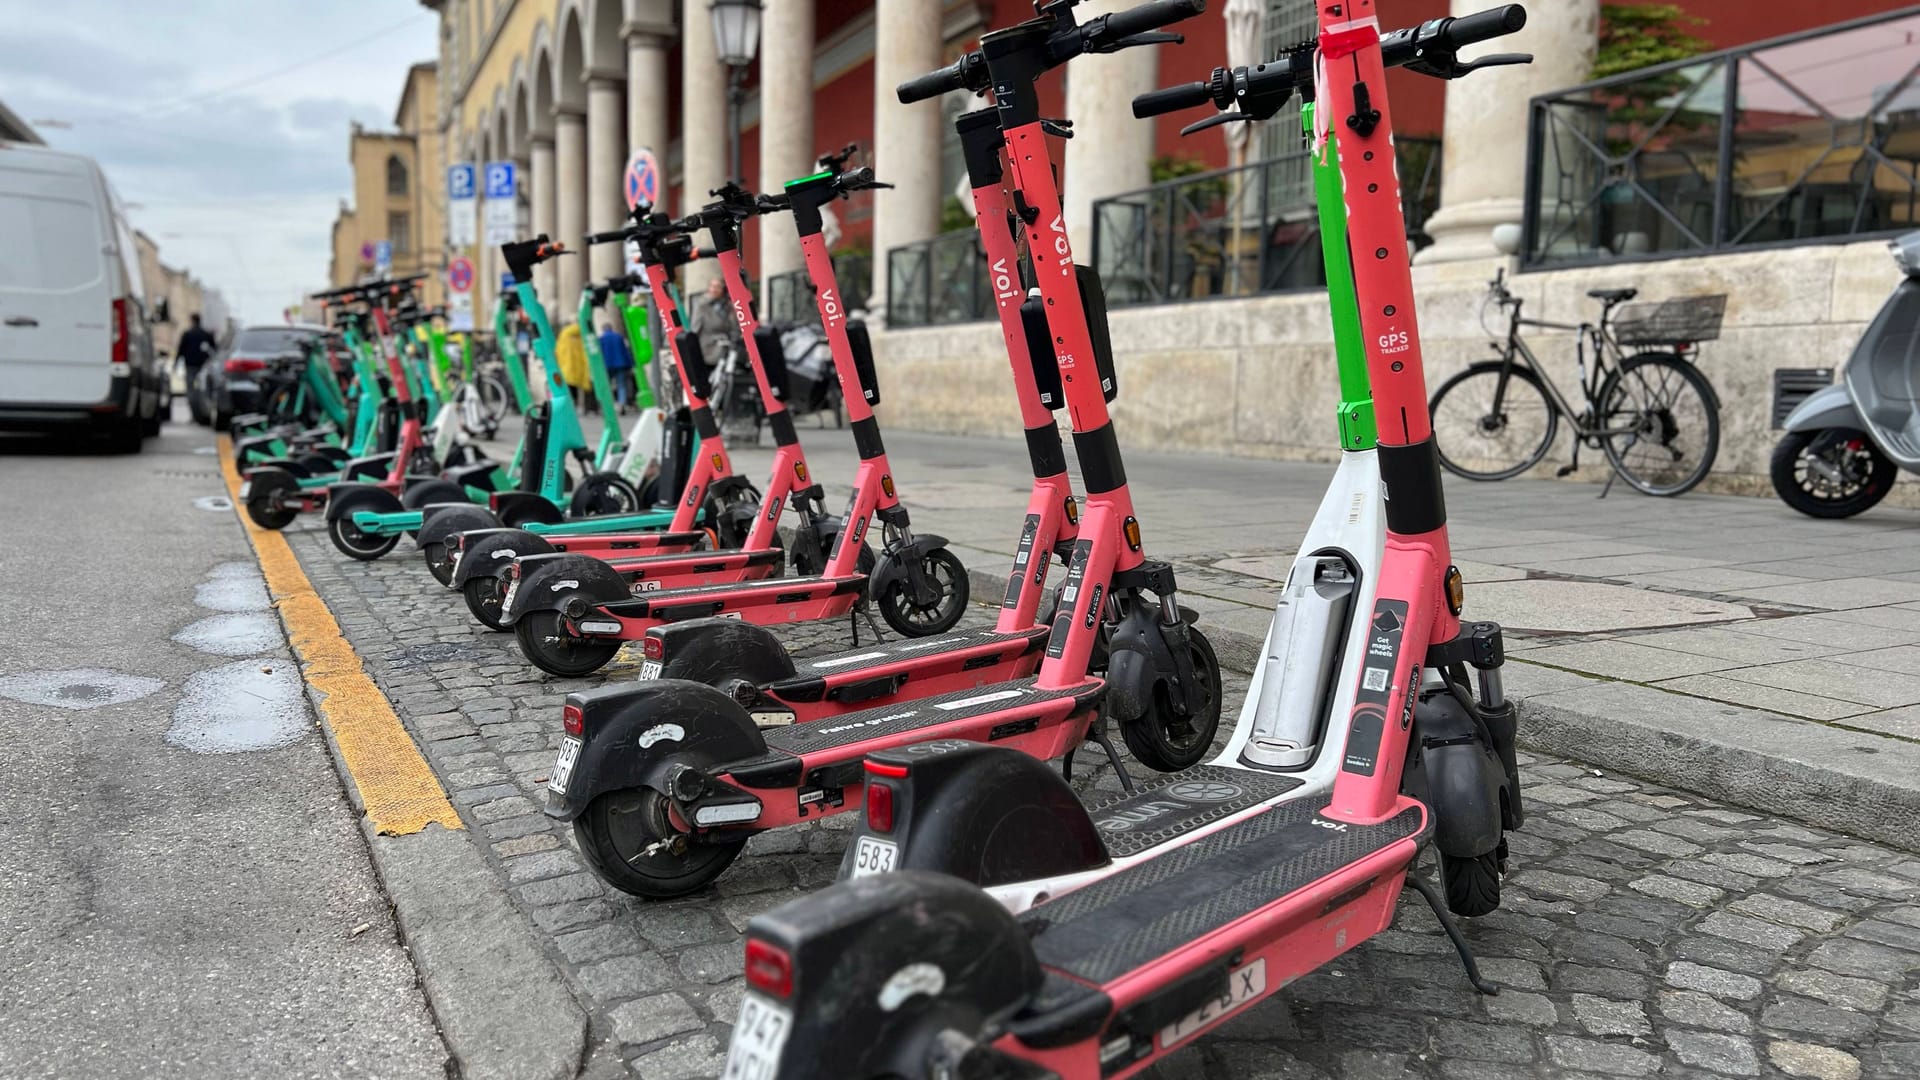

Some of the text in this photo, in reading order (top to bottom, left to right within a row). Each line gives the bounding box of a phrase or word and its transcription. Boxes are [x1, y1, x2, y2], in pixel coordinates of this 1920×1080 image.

[993, 258, 1018, 307] voi.
[733, 300, 751, 333] voi.
[822, 289, 842, 328] voi.
[1379, 331, 1408, 348] GPS
[1381, 344, 1409, 355] TRACKED
[1372, 643, 1393, 651] magic
[1377, 636, 1389, 644] Get
[1369, 649, 1393, 657] wheels
[560, 740, 579, 763] 987
[1096, 801, 1191, 831] Lime
[1311, 818, 1348, 832] voi.
[858, 843, 893, 872] 583
[741, 1002, 784, 1052] 947
